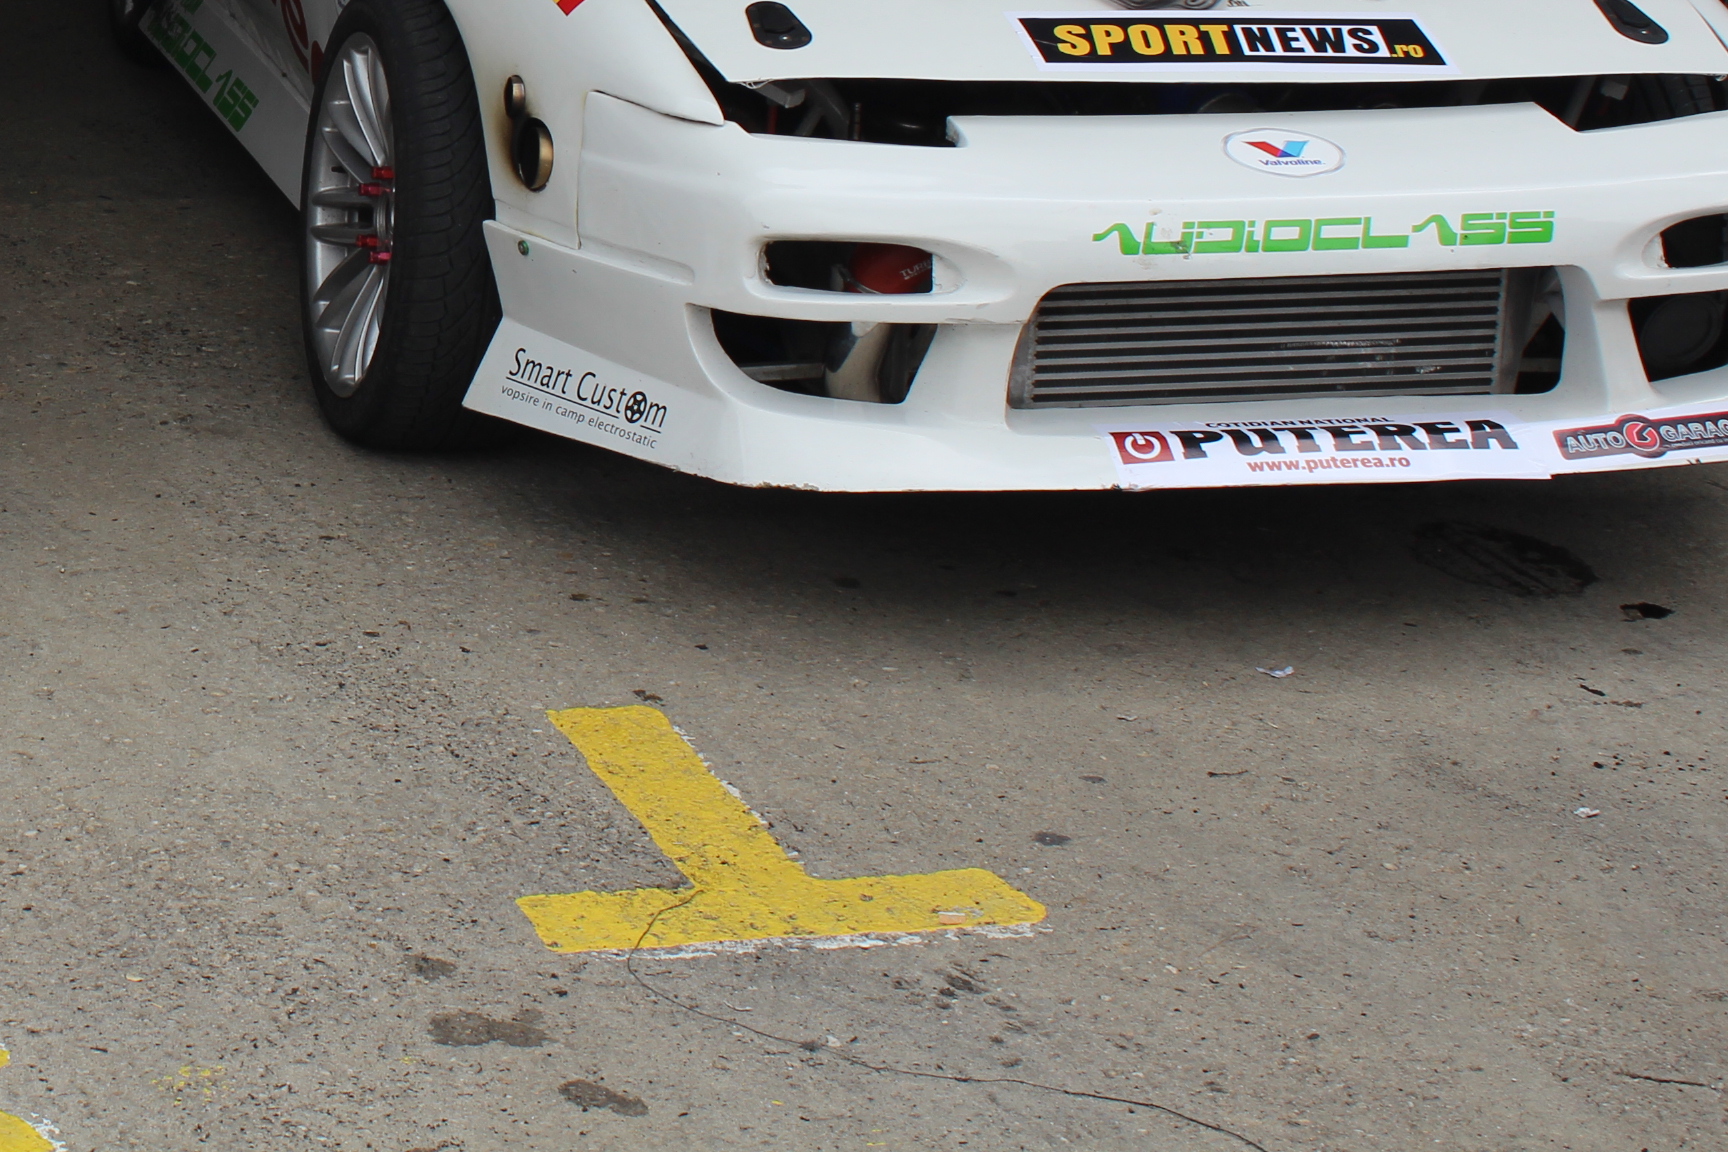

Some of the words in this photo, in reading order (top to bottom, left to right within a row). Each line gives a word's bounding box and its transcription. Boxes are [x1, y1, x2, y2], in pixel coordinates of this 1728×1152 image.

[508, 347, 573, 395] Smart
[501, 384, 540, 407] vopsire
[541, 397, 553, 413] in
[555, 406, 585, 425] camp
[587, 416, 658, 450] electrostatic
[1205, 419, 1301, 428] COTIDIAN
[1301, 416, 1395, 427] NATIONAL
[1169, 419, 1520, 460] PUTEREA
[1566, 431, 1627, 454] AUTO
[1659, 419, 1728, 442] GARAG
[1246, 455, 1412, 473] www.puterea.ro
